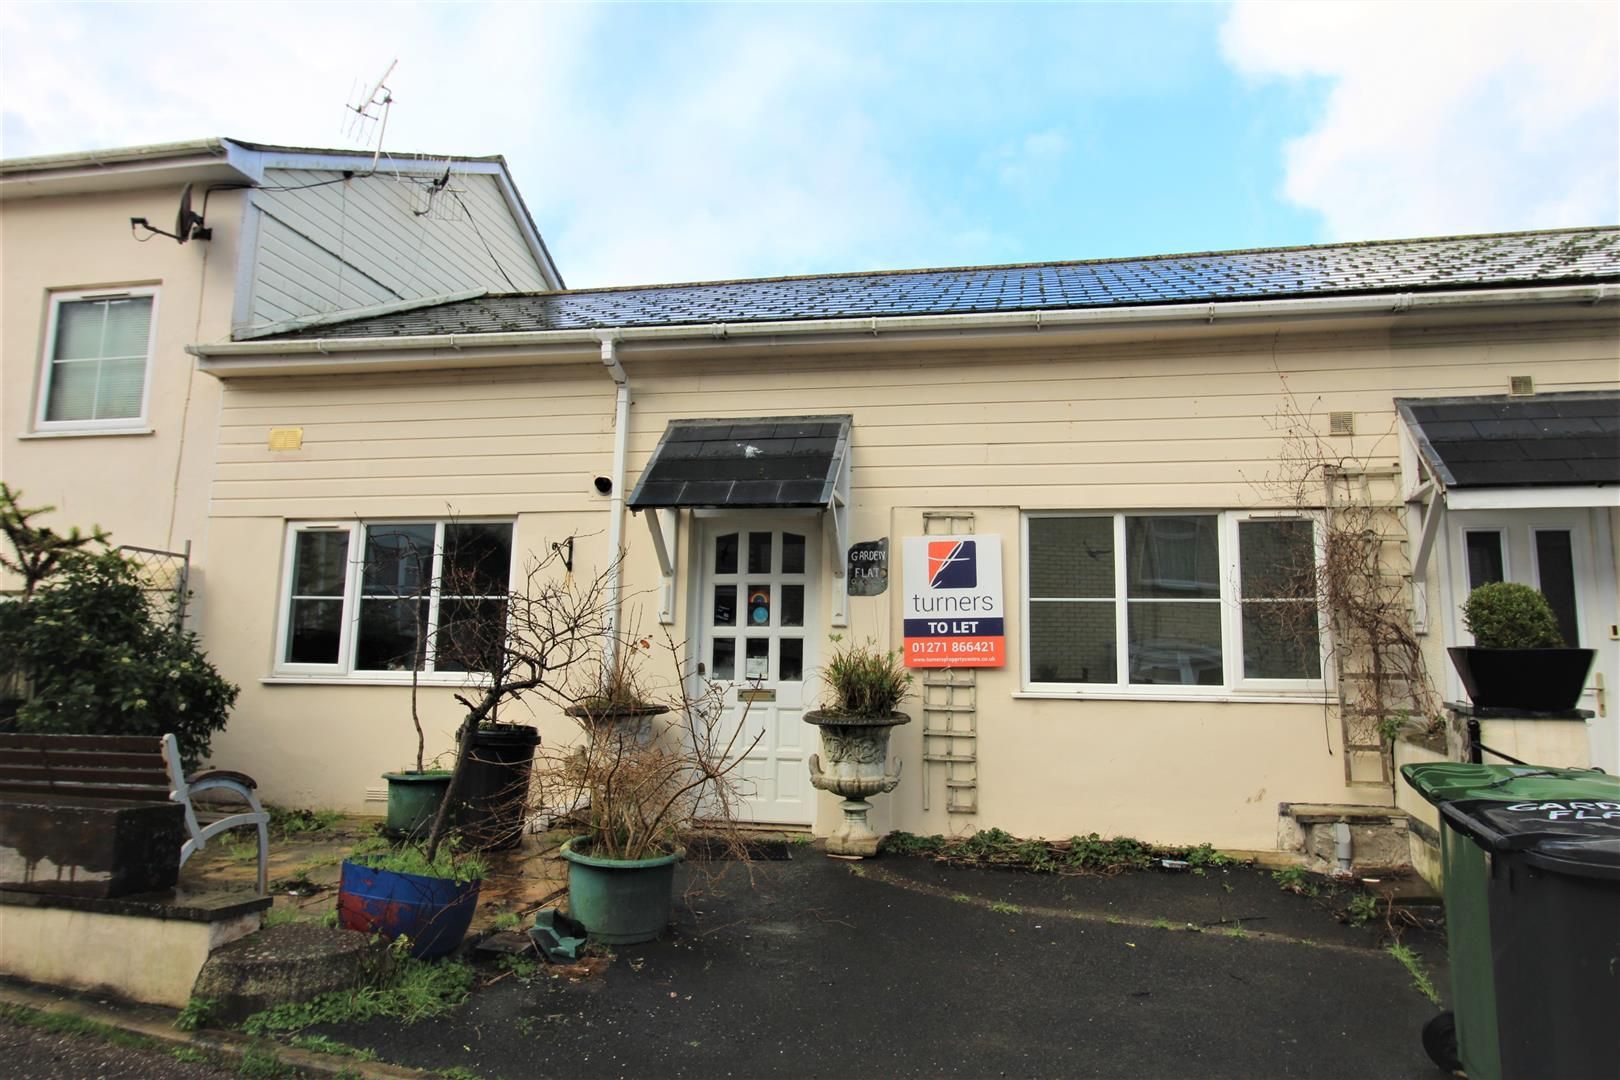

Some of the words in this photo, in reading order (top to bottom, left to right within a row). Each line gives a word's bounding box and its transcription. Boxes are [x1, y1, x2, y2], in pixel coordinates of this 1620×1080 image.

[851, 550, 886, 561] GARDEN
[855, 567, 879, 578] FLAT
[912, 593, 994, 612] turners
[928, 622, 948, 634] TO
[953, 621, 979, 633] LET
[912, 642, 947, 653] 01271
[952, 641, 994, 652] 866421
